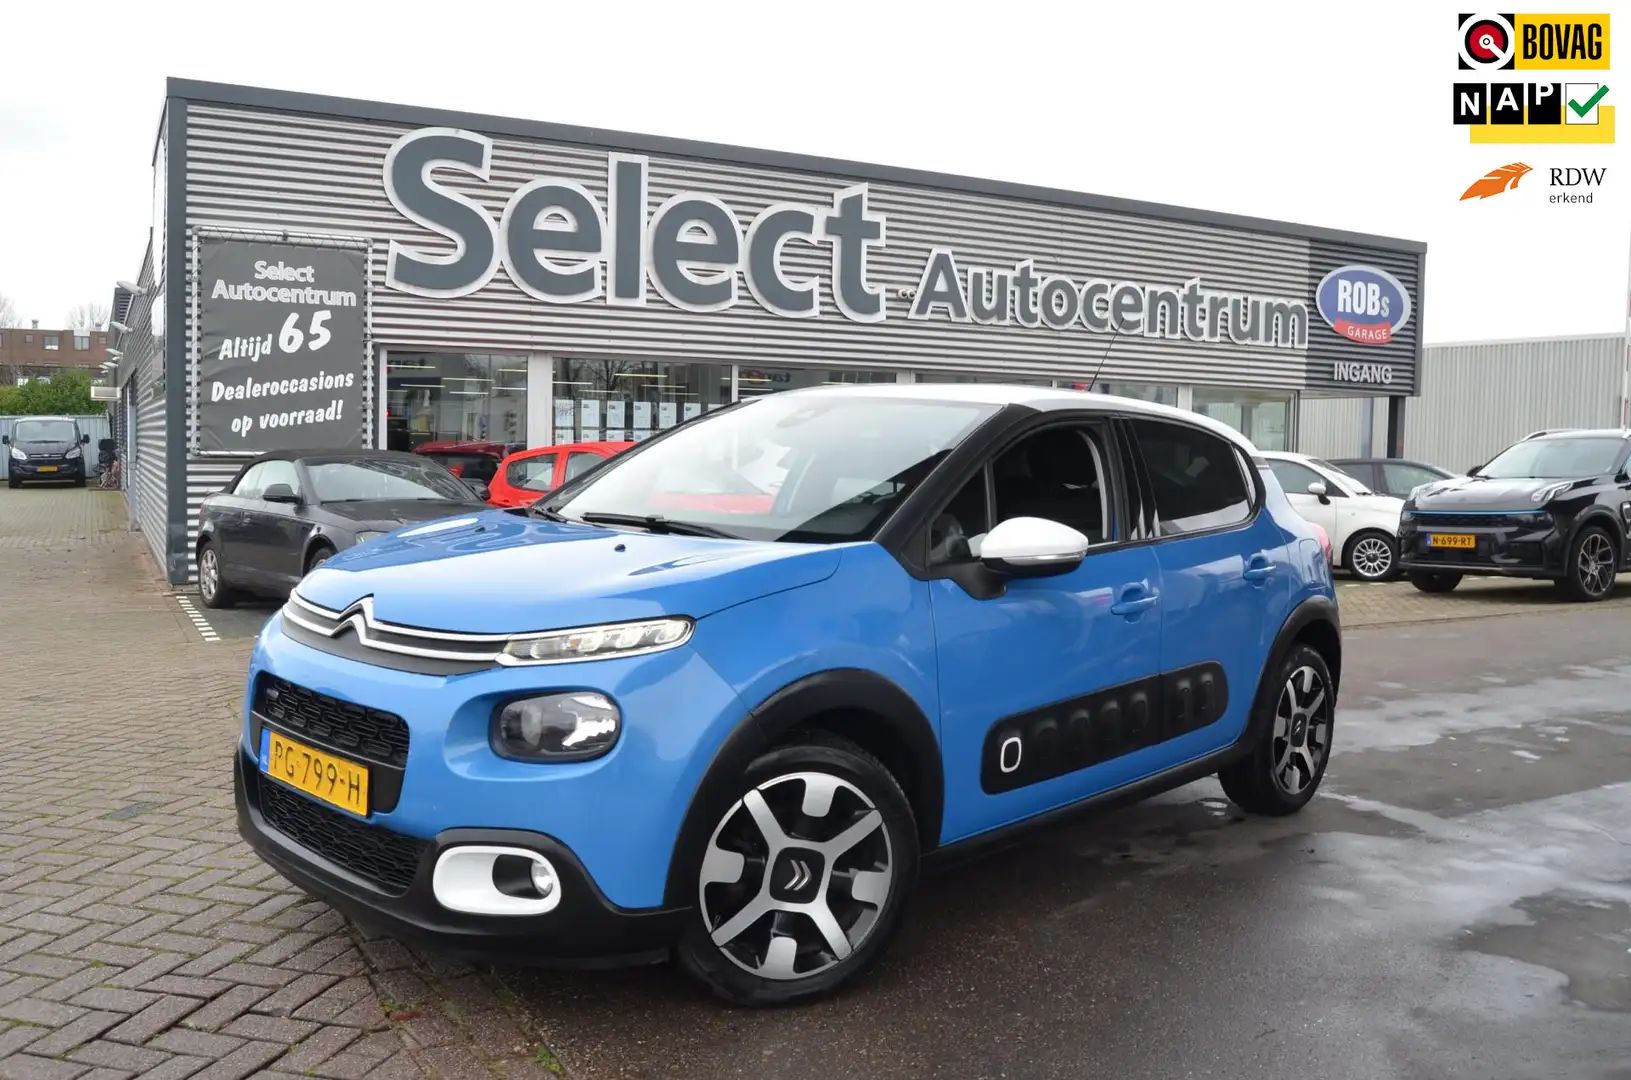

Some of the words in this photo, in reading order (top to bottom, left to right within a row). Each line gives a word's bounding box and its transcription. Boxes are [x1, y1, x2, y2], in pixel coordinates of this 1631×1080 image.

[383, 126, 886, 324] Select
[254, 260, 315, 282] Select
[211, 279, 356, 306] Autocentrum
[908, 247, 1309, 349] Autocentrum
[218, 334, 273, 362] Altijd
[278, 310, 332, 353] 65
[1347, 325, 1388, 340] GARAGE
[211, 371, 354, 402] Dealeroccasions
[1333, 360, 1392, 385] INGANG
[230, 415, 253, 437] op
[259, 399, 344, 430] voorraad!
